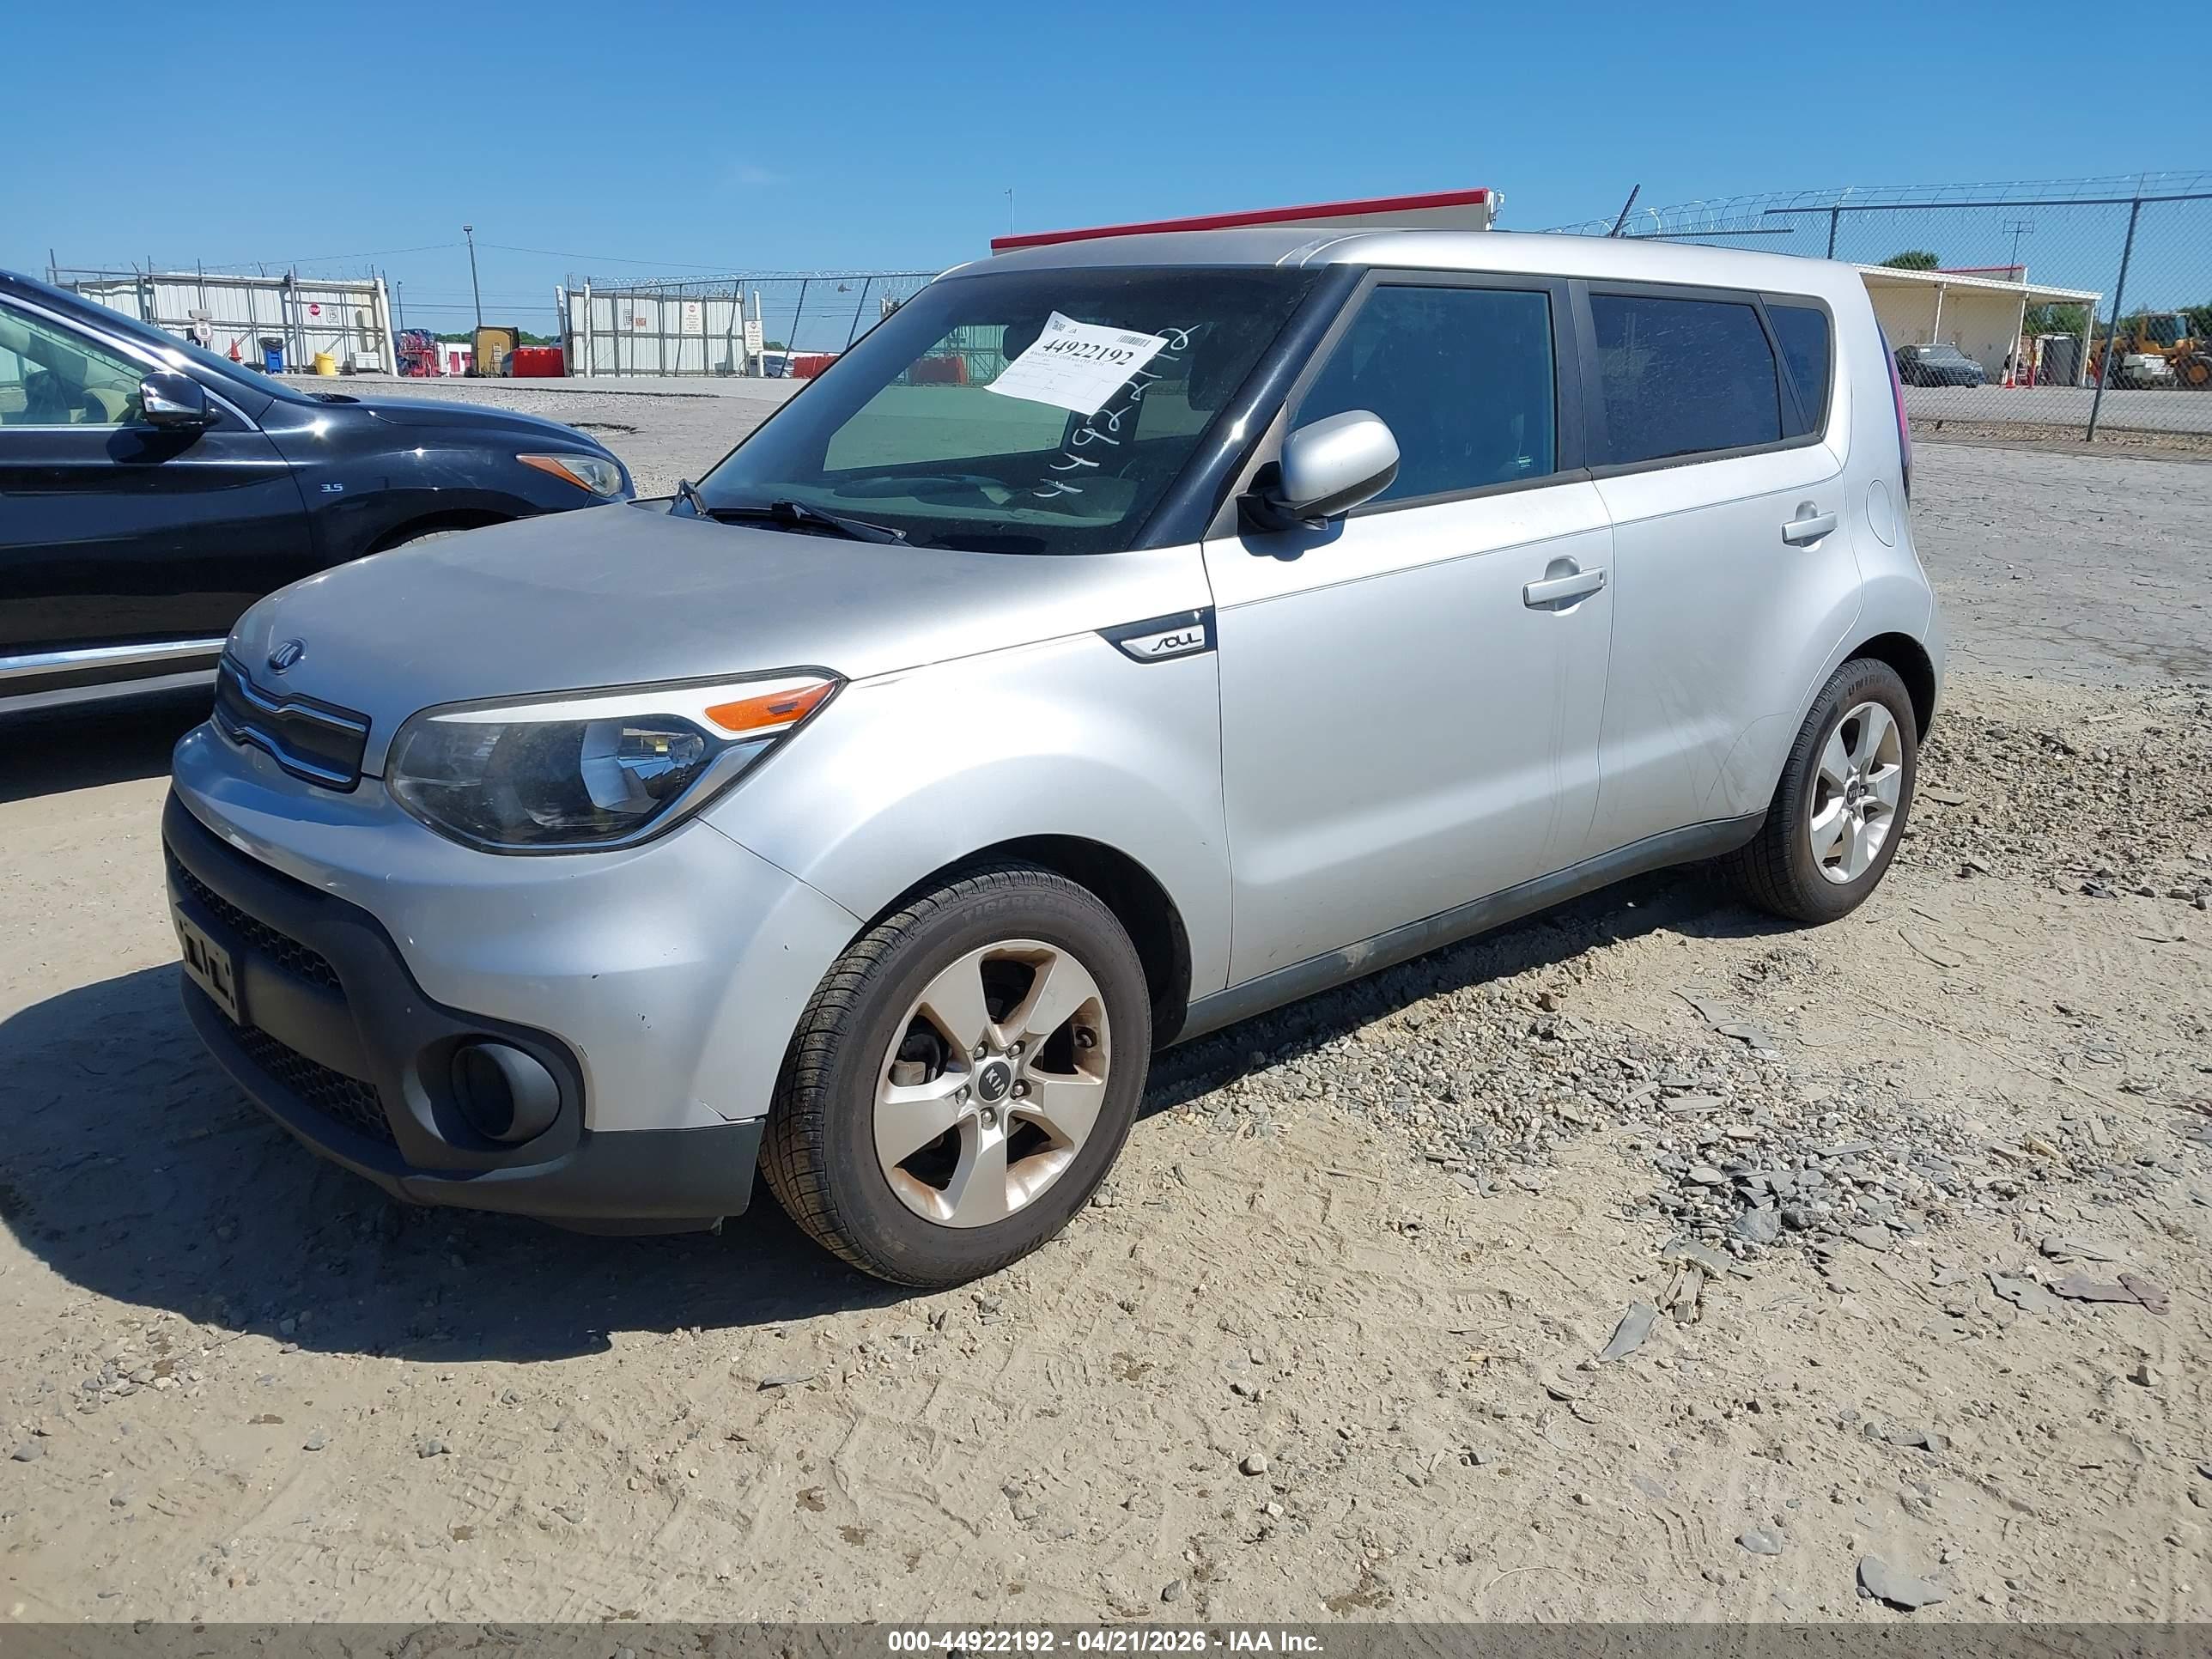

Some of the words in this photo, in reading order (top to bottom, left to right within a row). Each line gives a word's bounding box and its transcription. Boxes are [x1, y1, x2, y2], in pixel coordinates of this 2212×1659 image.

[1042, 338, 1134, 366] 44922192
[1152, 633, 1202, 653] SOUL
[985, 1067, 1006, 1097] KIA
